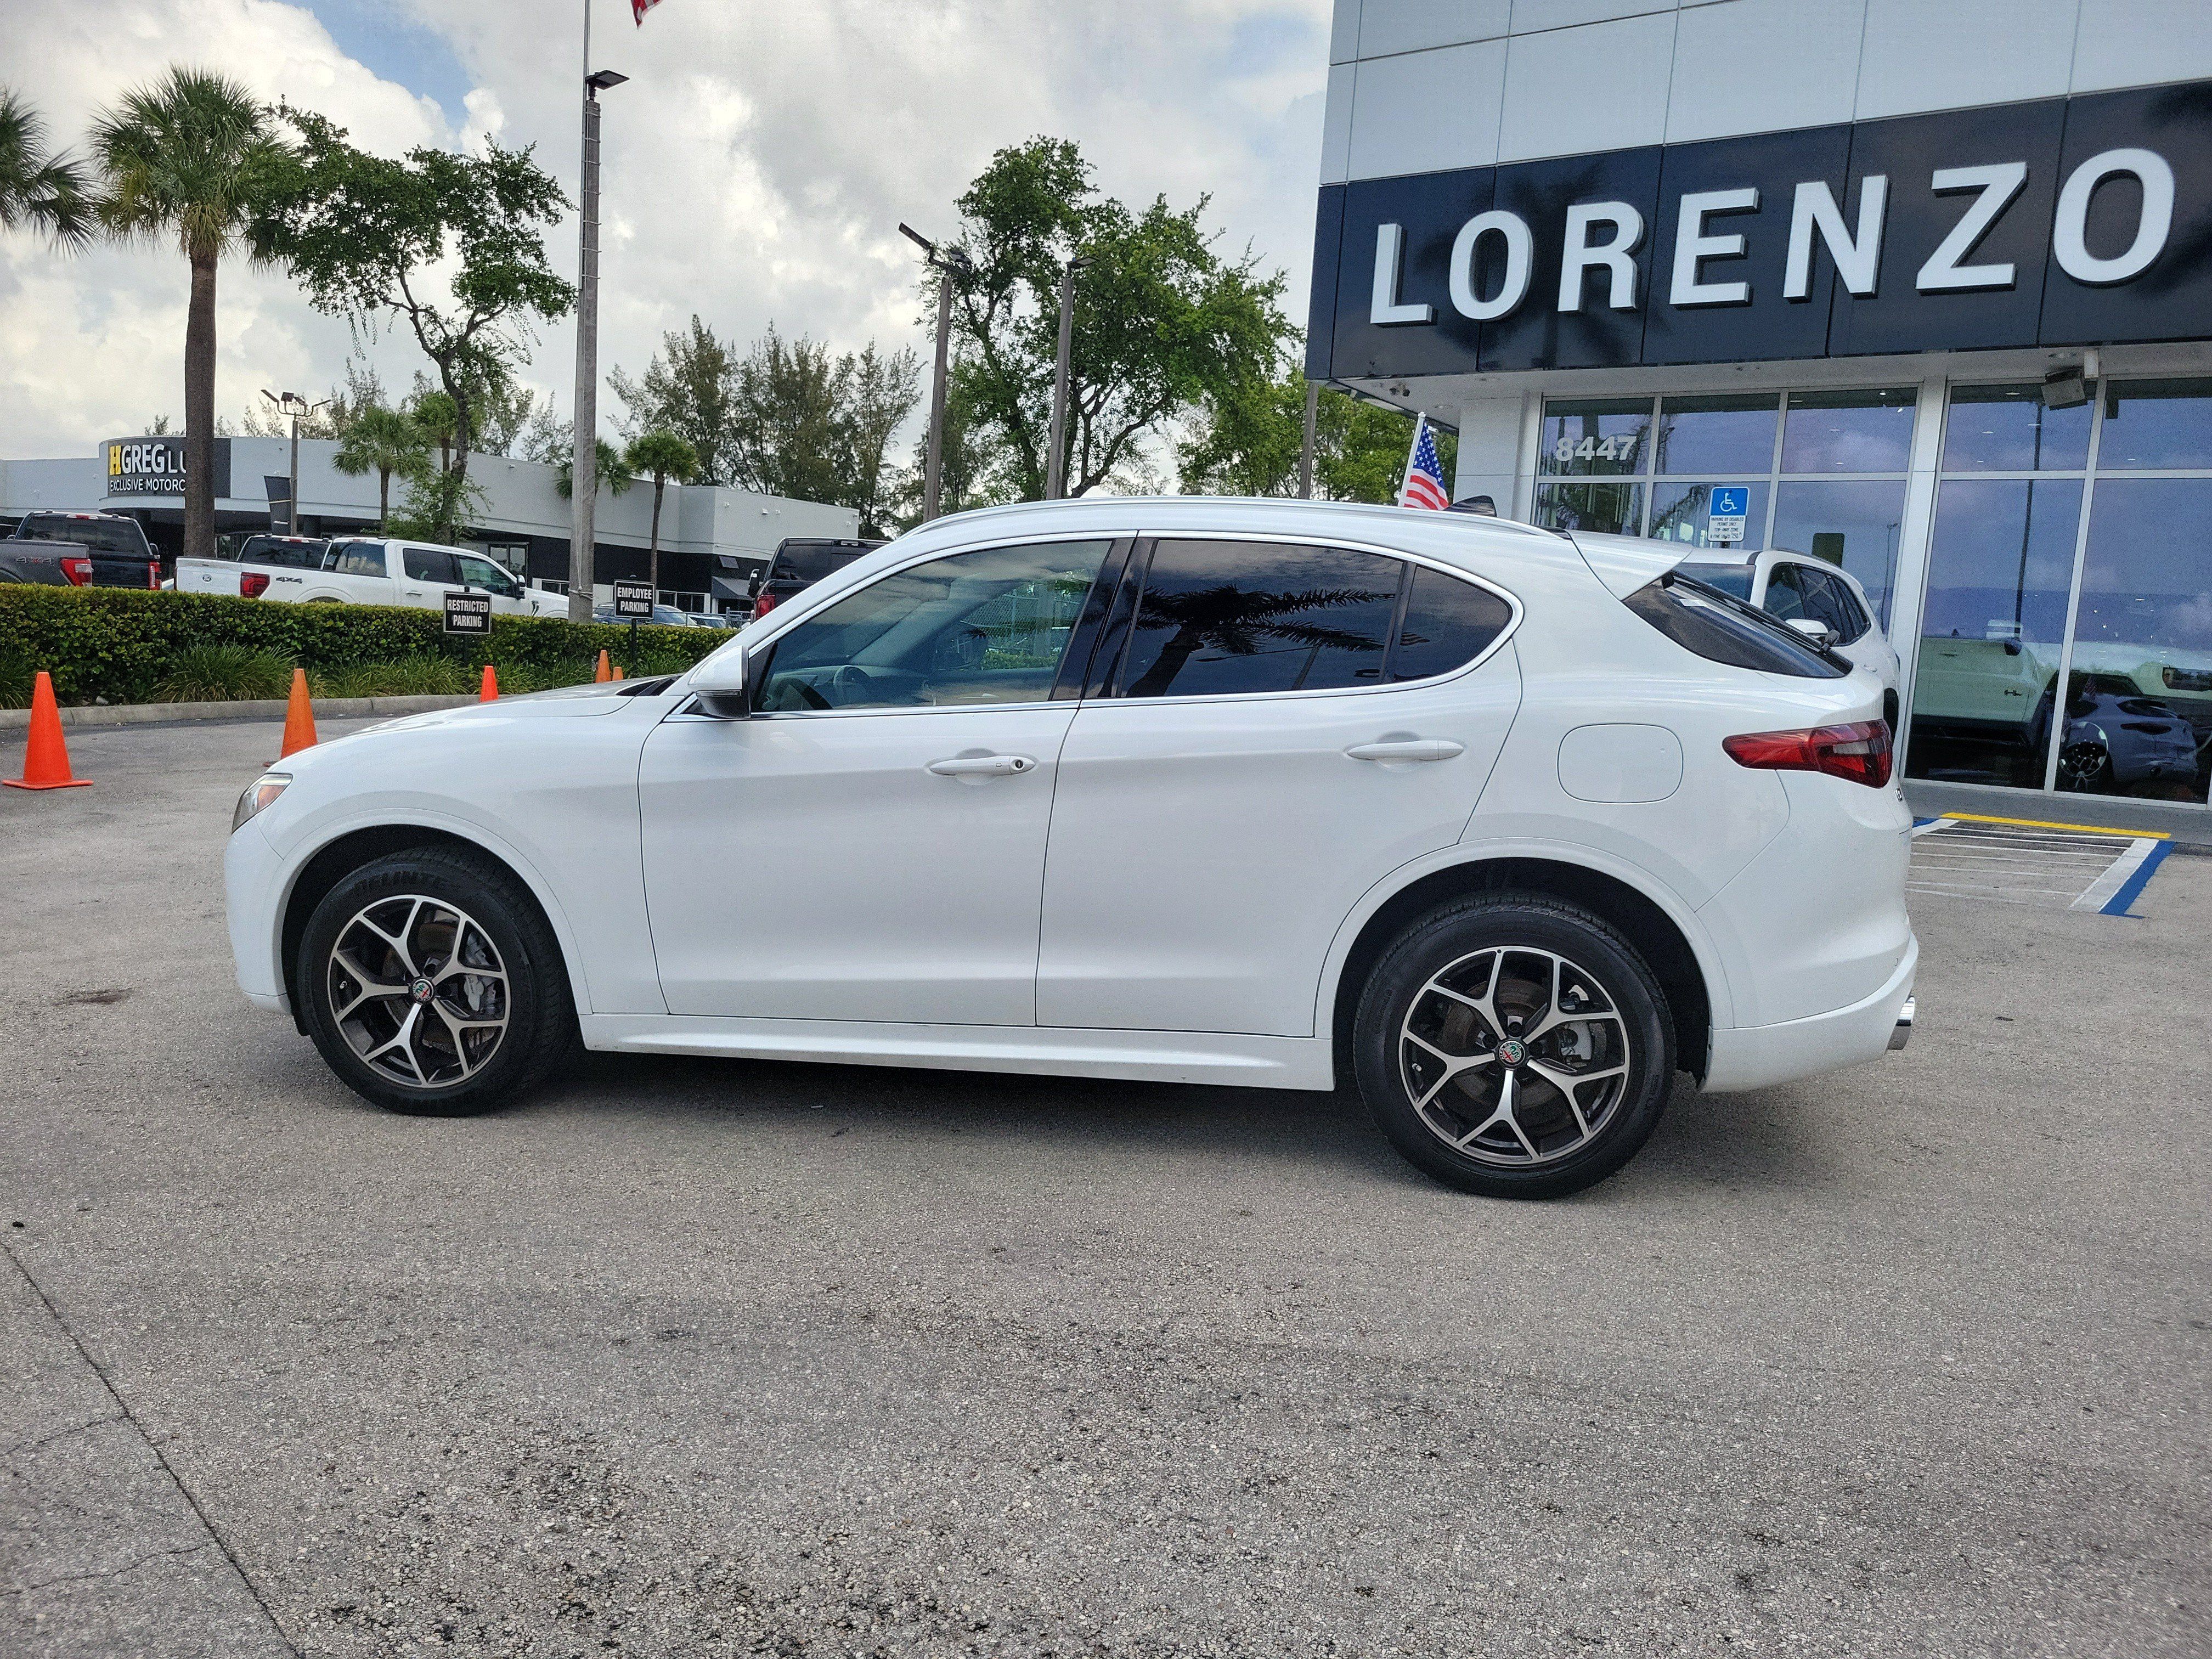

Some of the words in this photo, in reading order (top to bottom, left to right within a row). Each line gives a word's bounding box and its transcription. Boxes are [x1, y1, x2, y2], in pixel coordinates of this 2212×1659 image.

[1370, 147, 2177, 328] LORENZO
[1555, 436, 1637, 461] 8447
[110, 478, 144, 492] EXCLUSIVE
[617, 586, 652, 600] EMPLOYEE
[447, 599, 489, 613] RESTRICTED
[620, 600, 650, 613] PARKING
[453, 614, 482, 628] PARKING
